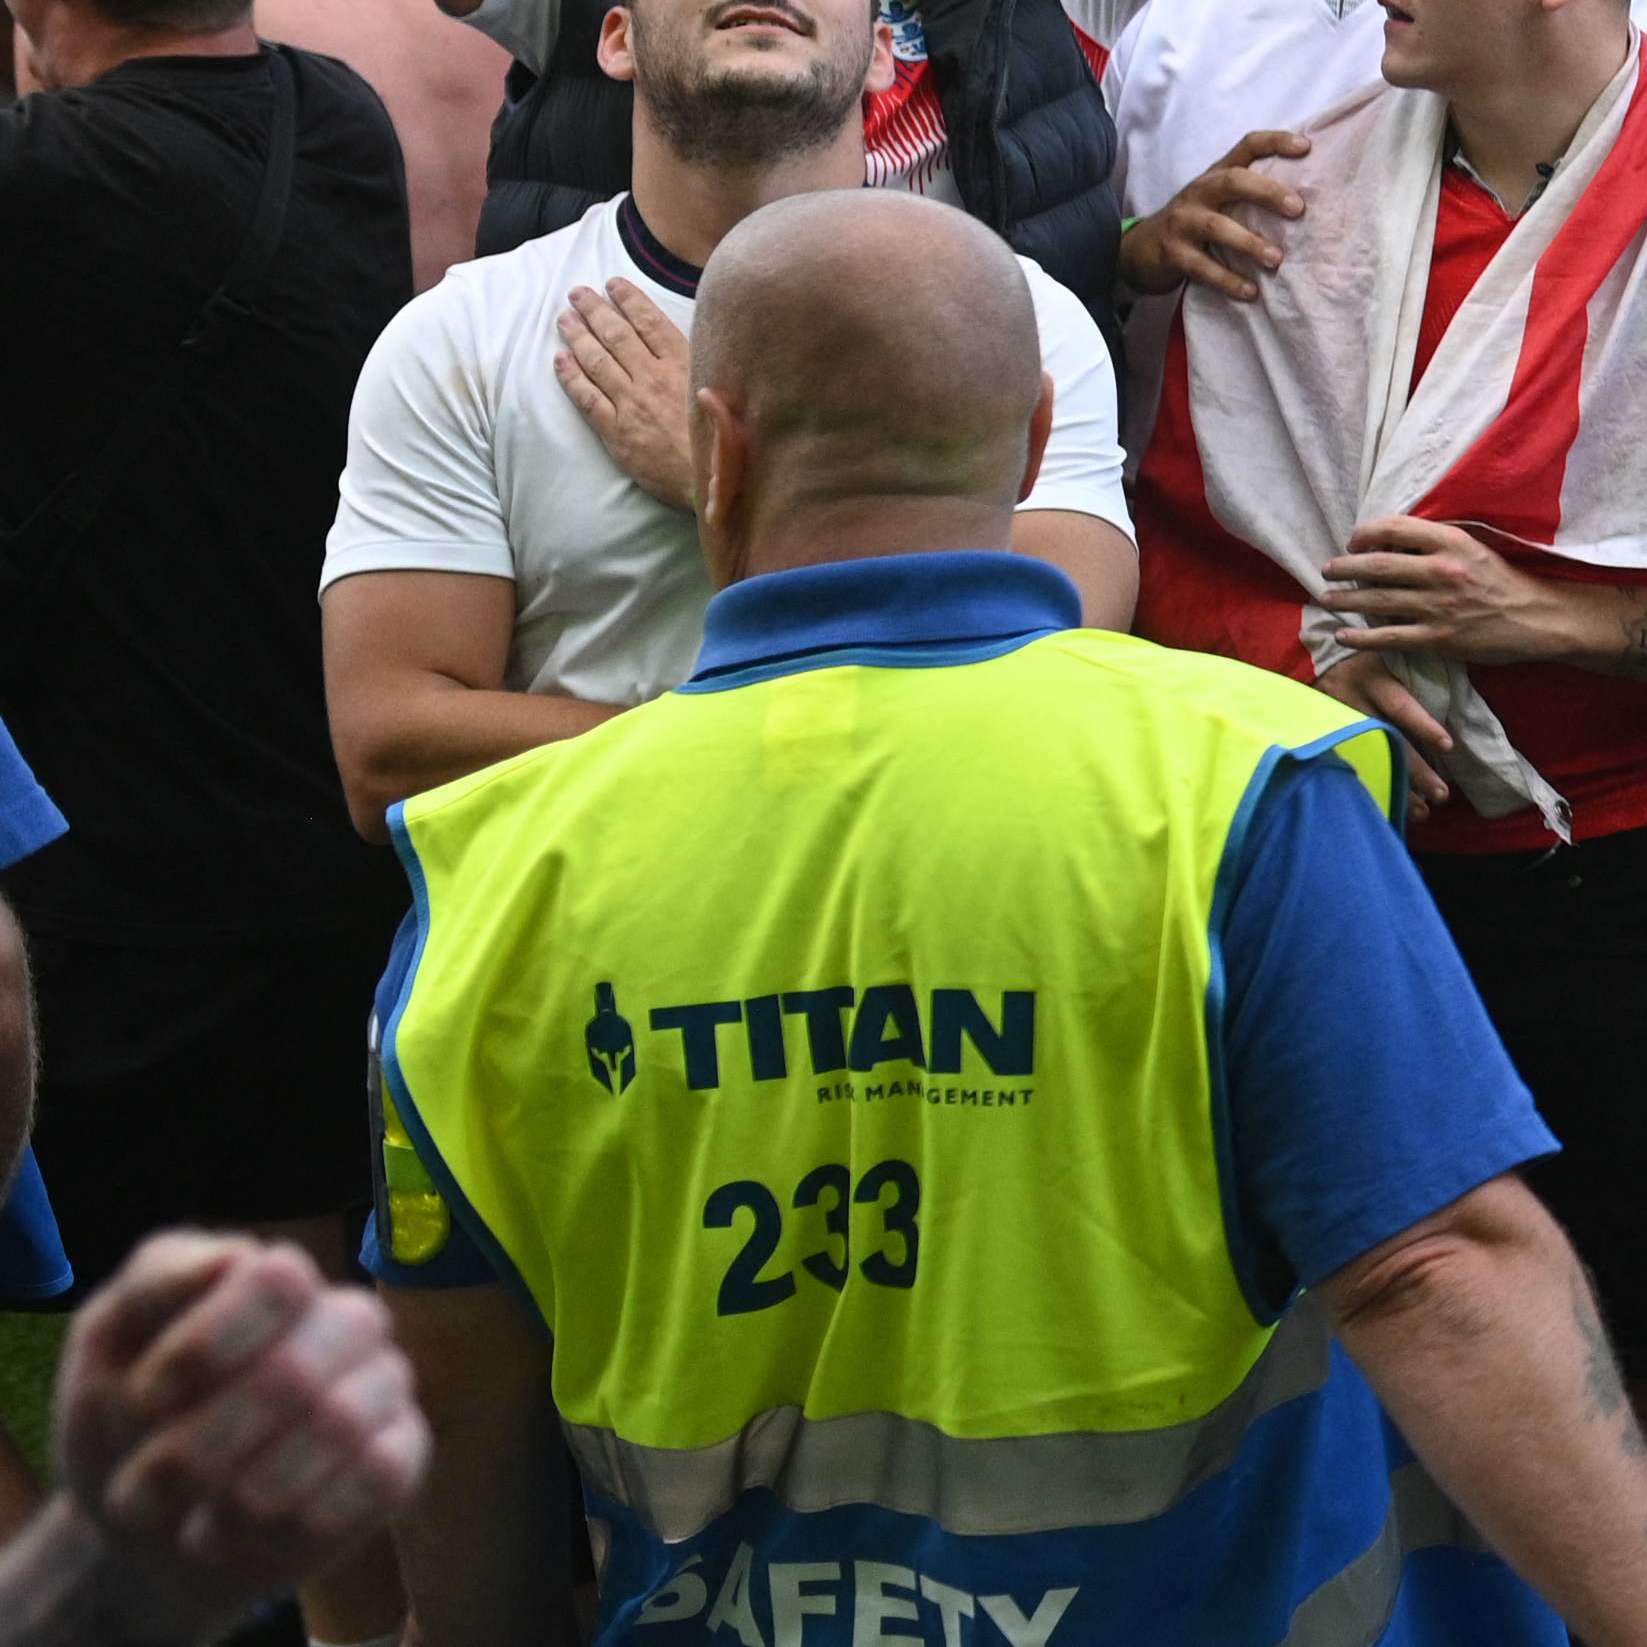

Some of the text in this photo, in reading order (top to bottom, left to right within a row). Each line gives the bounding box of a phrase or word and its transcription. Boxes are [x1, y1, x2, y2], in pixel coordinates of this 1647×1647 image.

[649, 984, 1036, 1090] TITAN
[865, 1080, 1034, 1106] MANGEMENT
[703, 1159, 920, 1316] 233
[632, 1541, 1080, 1647] SAFETY
